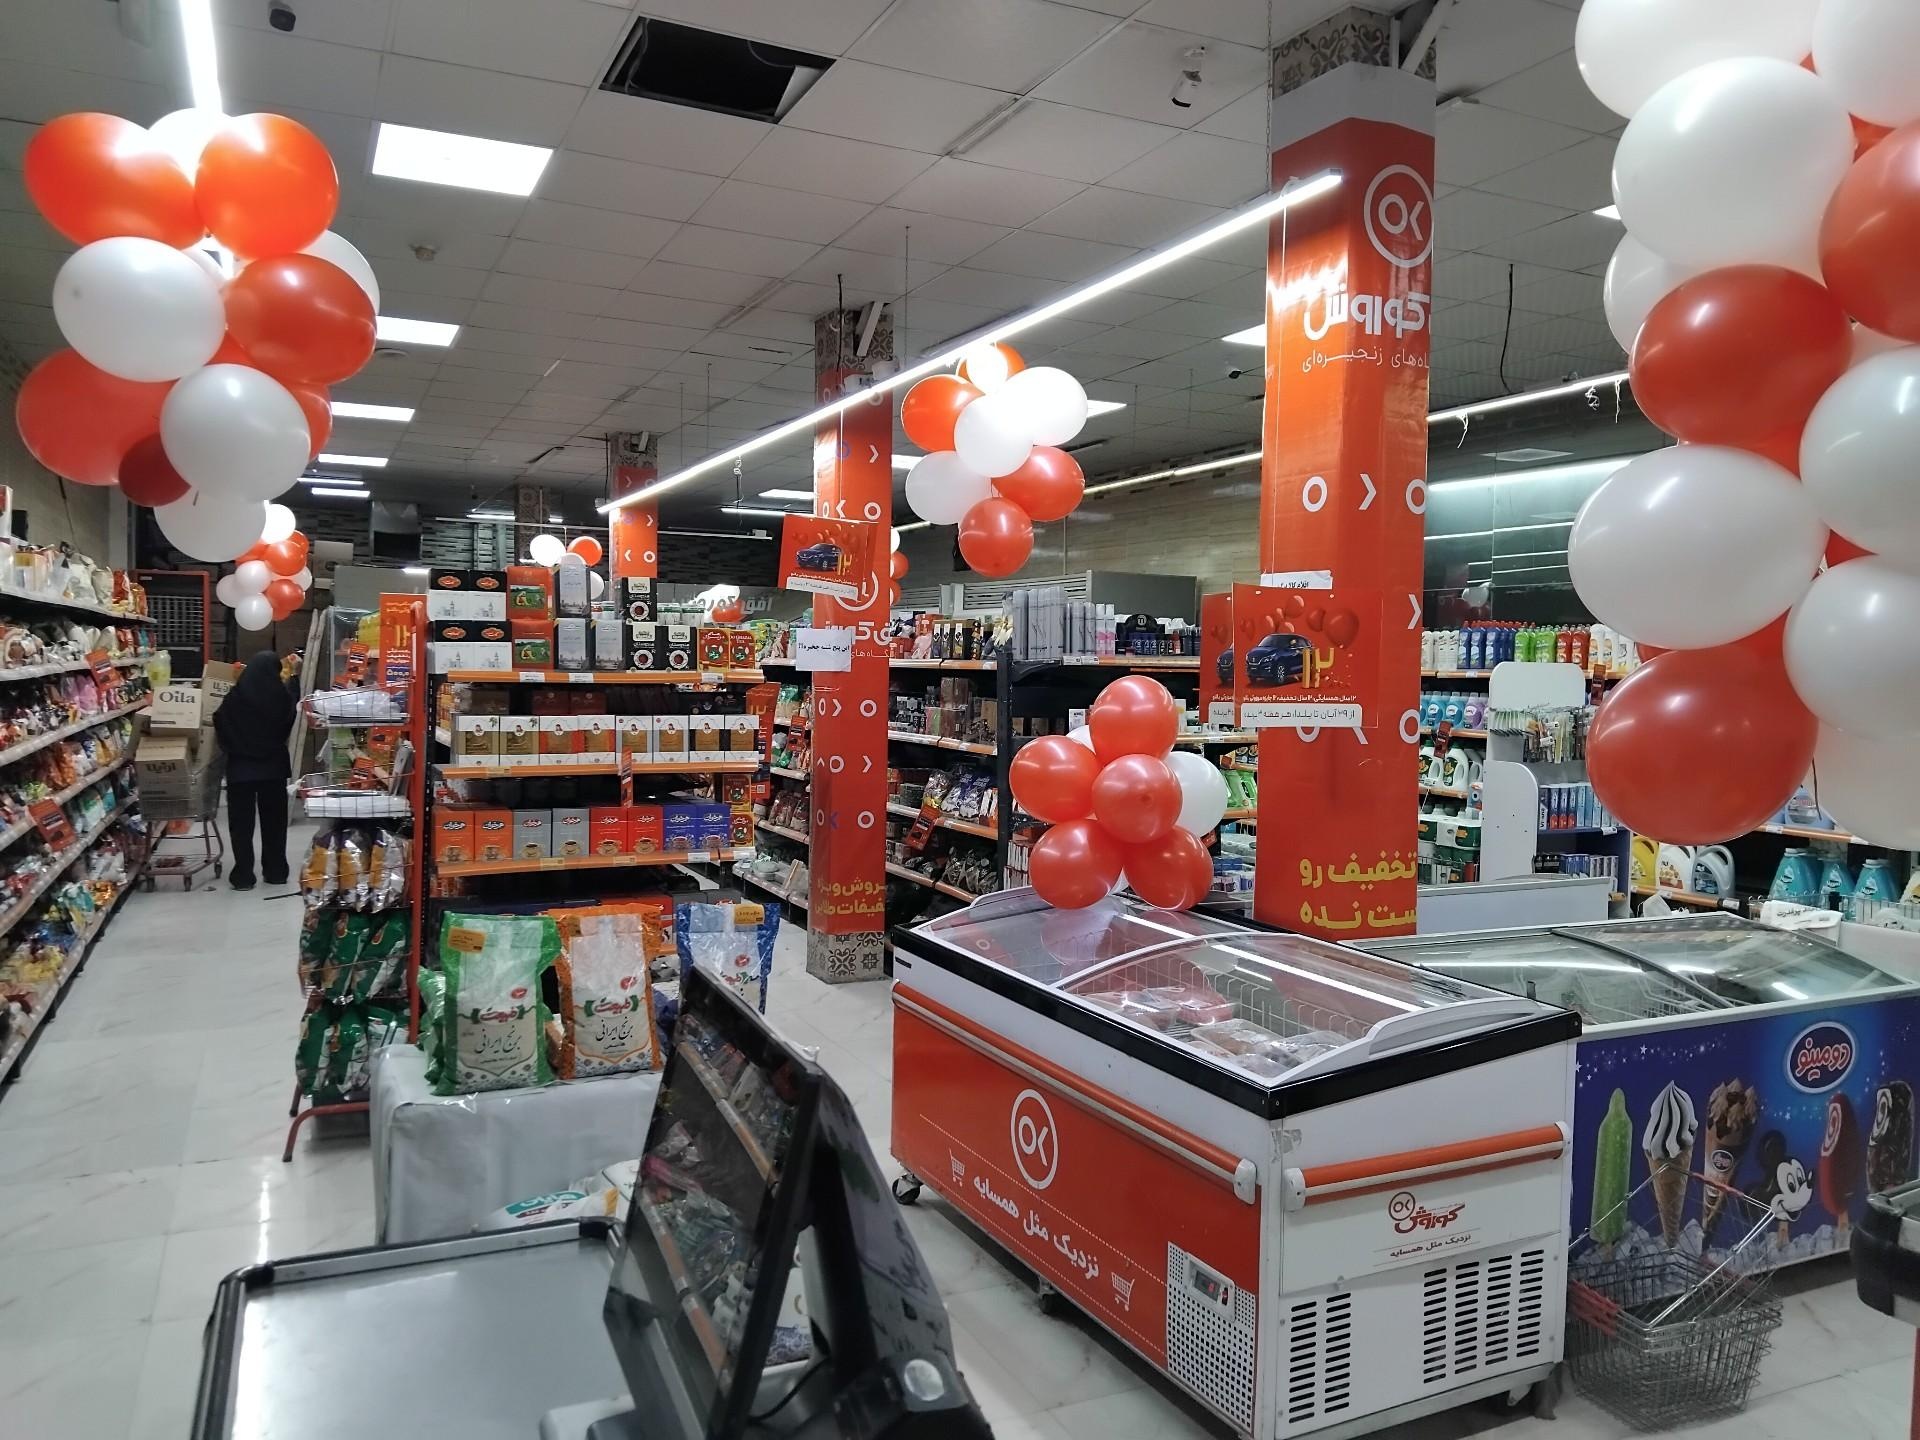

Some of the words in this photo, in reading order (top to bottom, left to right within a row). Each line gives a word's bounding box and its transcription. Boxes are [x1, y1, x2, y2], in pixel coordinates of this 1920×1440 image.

[1302, 647, 1335, 689] ۱۲
[159, 690, 196, 704] Oila
[1300, 858, 1322, 889] رو
[1328, 850, 1417, 891] تخفیف
[842, 877, 888, 897] روش
[1300, 901, 1361, 929] نده
[1367, 905, 1417, 928] ست
[1795, 1037, 1851, 1082] دومینو
[973, 1176, 1020, 1219] همسایه
[1023, 1210, 1049, 1241] مثل
[1394, 1203, 1466, 1234] کوروش
[1390, 1246, 1424, 1257] همسایه
[1425, 1241, 1443, 1251] مثل
[1445, 1234, 1472, 1245] نزدیک
[1053, 1234, 1100, 1280] نزدیک
